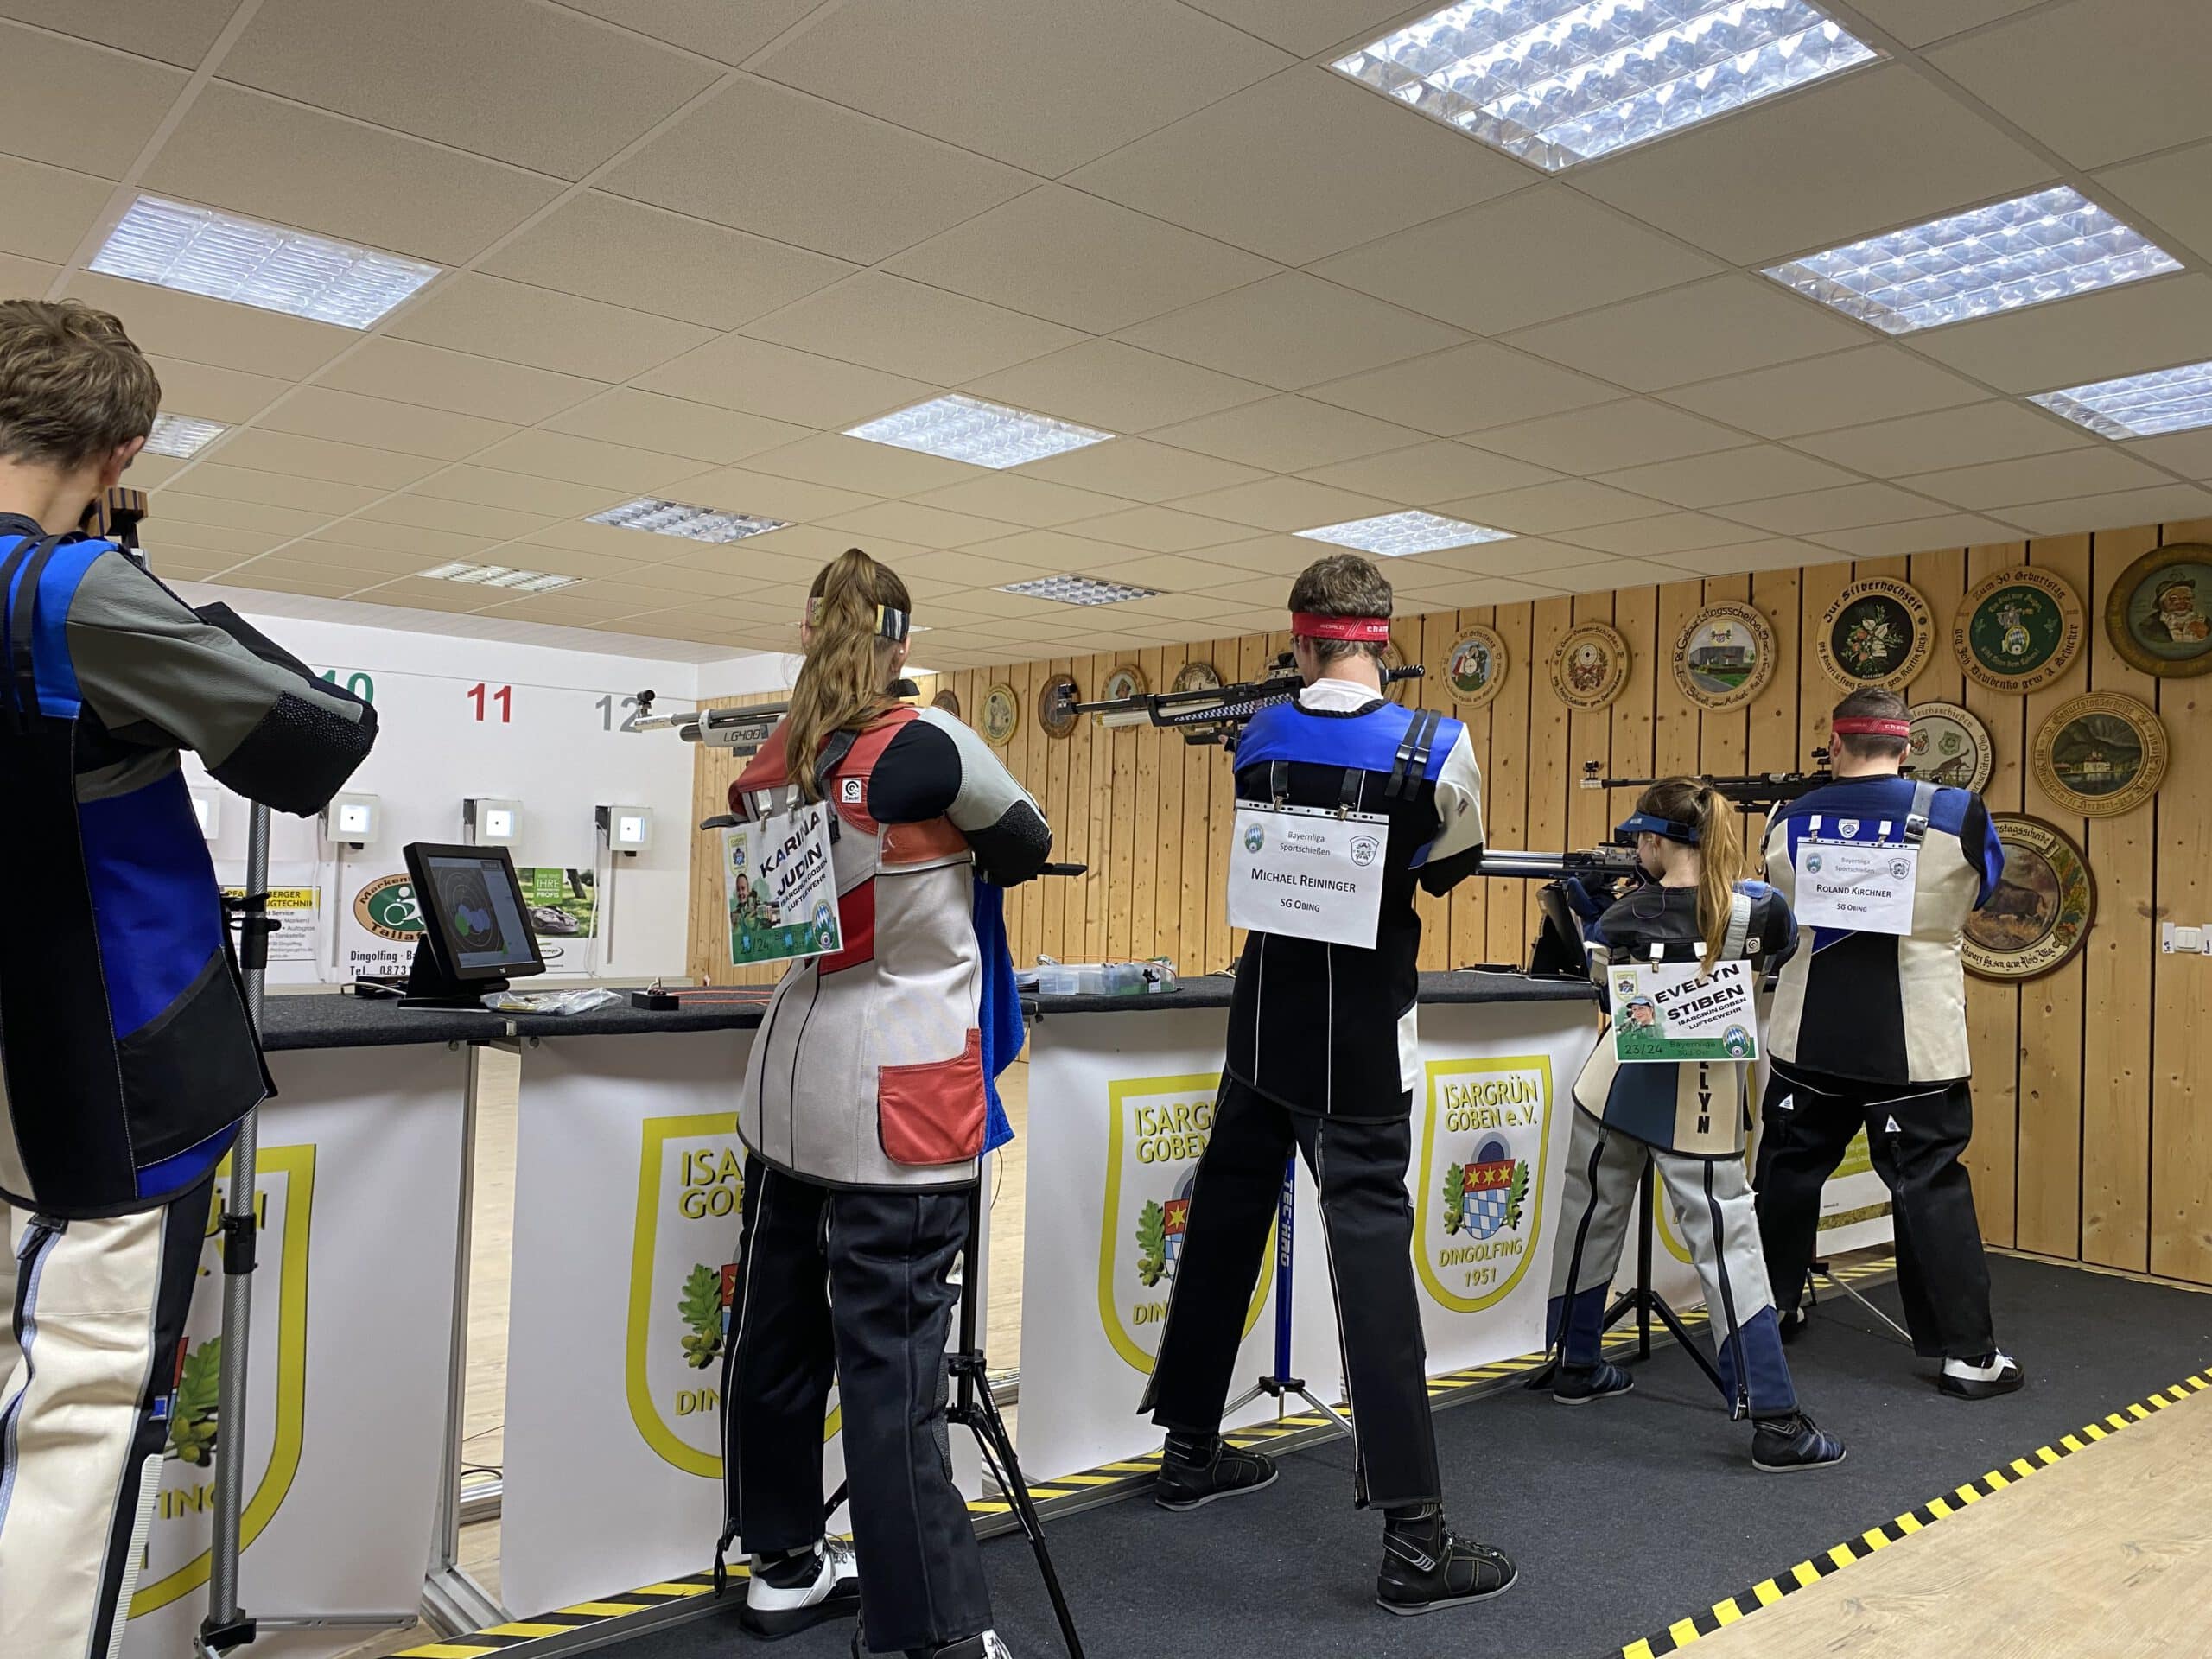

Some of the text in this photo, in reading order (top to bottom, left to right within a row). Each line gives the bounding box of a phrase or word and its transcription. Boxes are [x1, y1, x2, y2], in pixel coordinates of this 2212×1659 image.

[1841, 581, 1923, 612] Silberhochzeit
[2014, 571, 2066, 599] Geburtstag
[467, 683, 512, 723] 11
[595, 695, 643, 733] 12
[724, 729, 760, 742] LG400
[760, 811, 821, 878] KARINA
[1279, 842, 1331, 856] Sportschießen
[1287, 831, 1325, 842] Bayernliga
[778, 842, 823, 896] JUDIN
[1251, 868, 1356, 893] MICHAEL REININGER
[537, 879, 560, 888] IHRE
[1816, 884, 1891, 898] ROLAND KIRCHNER
[1280, 898, 1320, 912] SG OBING
[350, 951, 397, 963] Dingolfing
[1654, 963, 1740, 1004] EVELYN
[1667, 984, 1745, 1020] STIBEN
[1678, 997, 1747, 1027] ISARGRÜN GOBEN
[1688, 1007, 1742, 1030] LUFTGEWEHR
[1624, 1044, 1662, 1055] 23/24
[1443, 1074, 1538, 1109] ISARGRÜN
[1134, 1101, 1216, 1137] ISARG
[1445, 1105, 1538, 1133] GOBEN e.V.
[681, 1147, 749, 1187] ISA
[1439, 1237, 1522, 1268] DINGOLFING
[1465, 1268, 1497, 1287] 1951
